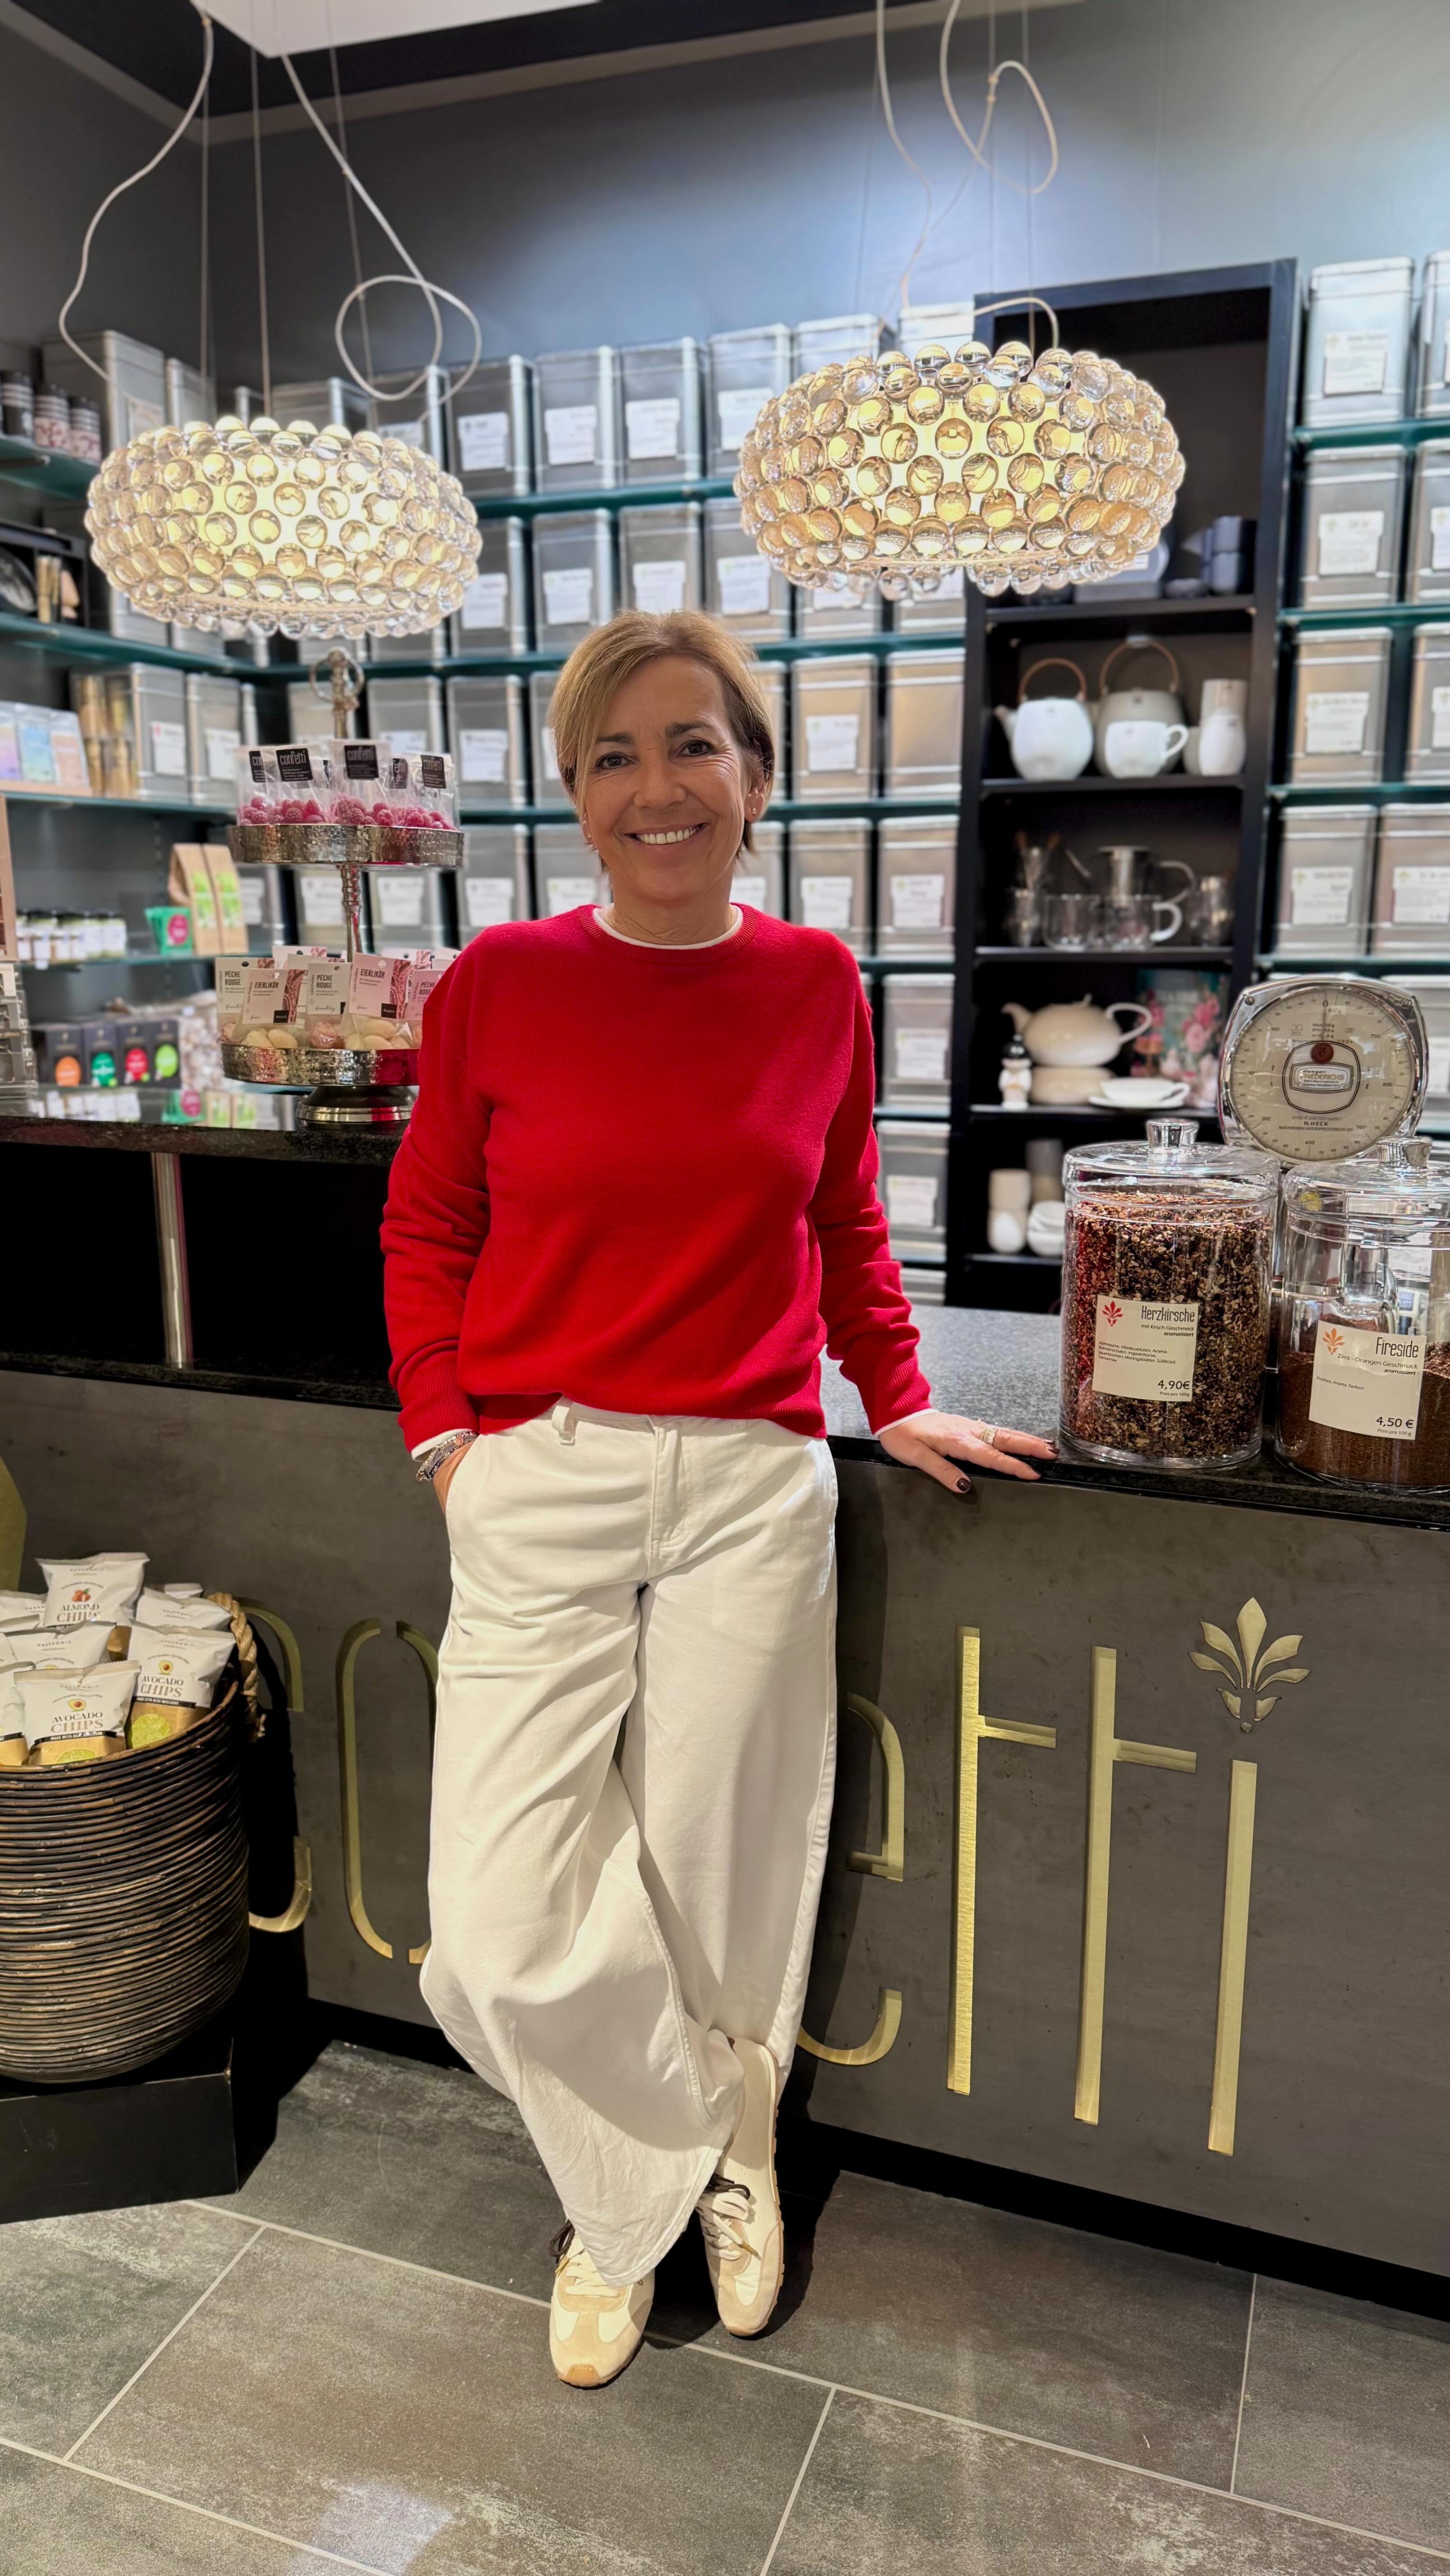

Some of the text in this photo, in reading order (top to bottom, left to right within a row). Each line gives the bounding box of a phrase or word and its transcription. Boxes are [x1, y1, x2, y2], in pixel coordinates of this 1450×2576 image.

[280, 751, 307, 765] confetti
[1141, 1305, 1195, 1322] Herzkirsche
[1376, 1337, 1419, 1358] Fireside
[1354, 1357, 1381, 1366] Orangen
[1383, 1361, 1418, 1369] Geschmack
[1158, 1380, 1190, 1390] 4,90€
[1376, 1417, 1414, 1429] 4,50 €
[60, 1603, 100, 1612] ALMOND
[142, 1675, 184, 1686] AVOCADO
[141, 1684, 183, 1697] CHIPS
[52, 1711, 103, 1723] AVOCADO
[51, 1719, 104, 1733] CHIPS
